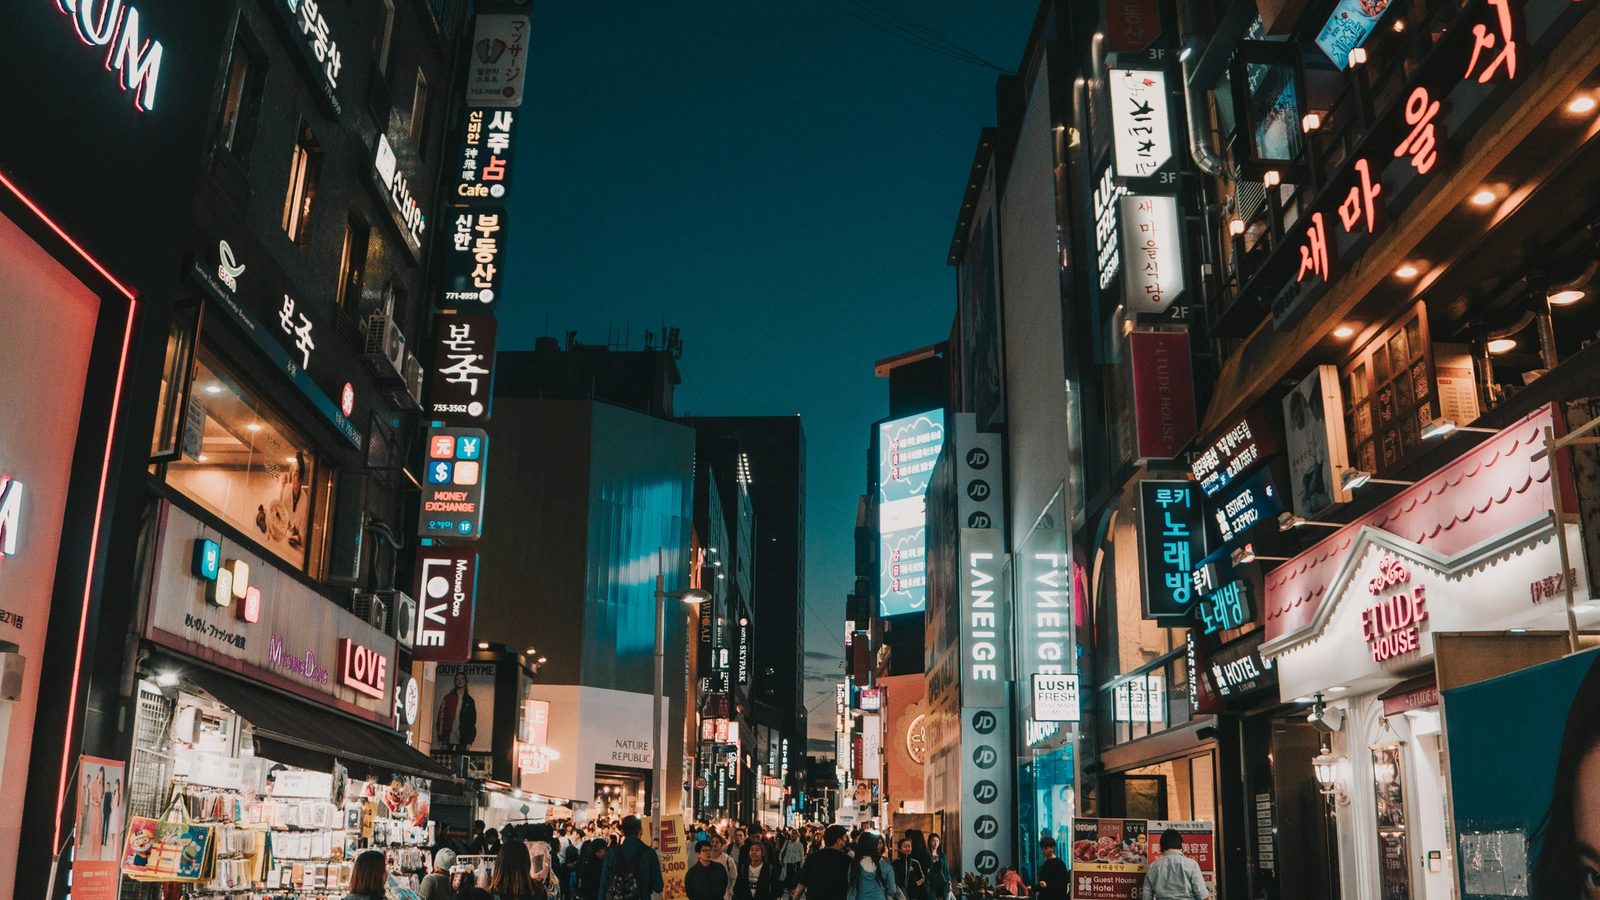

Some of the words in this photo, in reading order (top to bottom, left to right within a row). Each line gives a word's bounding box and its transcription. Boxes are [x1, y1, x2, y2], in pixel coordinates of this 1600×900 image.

[505, 20, 526, 82] マッサージ
[1149, 49, 1165, 60] 3F
[466, 110, 483, 145] 신비안
[1159, 172, 1177, 184] 3F
[458, 183, 490, 198] Cafe
[453, 214, 473, 252] 신한
[471, 213, 500, 289] 부동산
[1137, 199, 1164, 303] 새마을식당
[1171, 307, 1189, 318] 2F
[438, 323, 490, 396] 본죽
[433, 403, 467, 413] 755-3562
[436, 438, 452, 456] 元
[463, 438, 477, 457] ¥
[435, 462, 449, 482] $
[434, 491, 468, 502] MONEY
[1156, 488, 1191, 509] 루키
[425, 501, 475, 513] EXCHANGE
[460, 523, 471, 531] 1F
[1162, 511, 1194, 604] 노래방
[1192, 563, 1213, 597] 루키
[416, 557, 452, 647] LOVE
[1200, 581, 1244, 636] 노래방
[970, 552, 997, 681] LANEIGE
[1361, 585, 1429, 643] ETUDE
[1372, 627, 1421, 663] HOUSE
[343, 637, 387, 700] LOVE
[738, 645, 747, 683] SKYPARK
[1223, 654, 1260, 686] HOTEL
[1038, 680, 1075, 691] LUSH
[1038, 692, 1076, 702] FRESH
[1409, 690, 1433, 706] ETUDE
[975, 717, 994, 728] JD
[615, 739, 649, 751] NATURE
[612, 751, 651, 764] REPUBLIC
[975, 751, 995, 763] JD
[976, 786, 996, 798] JD
[976, 821, 996, 833] JD
[976, 856, 996, 868] JD
[1093, 876, 1114, 884] Guest
[1115, 876, 1137, 884] House
[1093, 884, 1114, 892] Hotel
